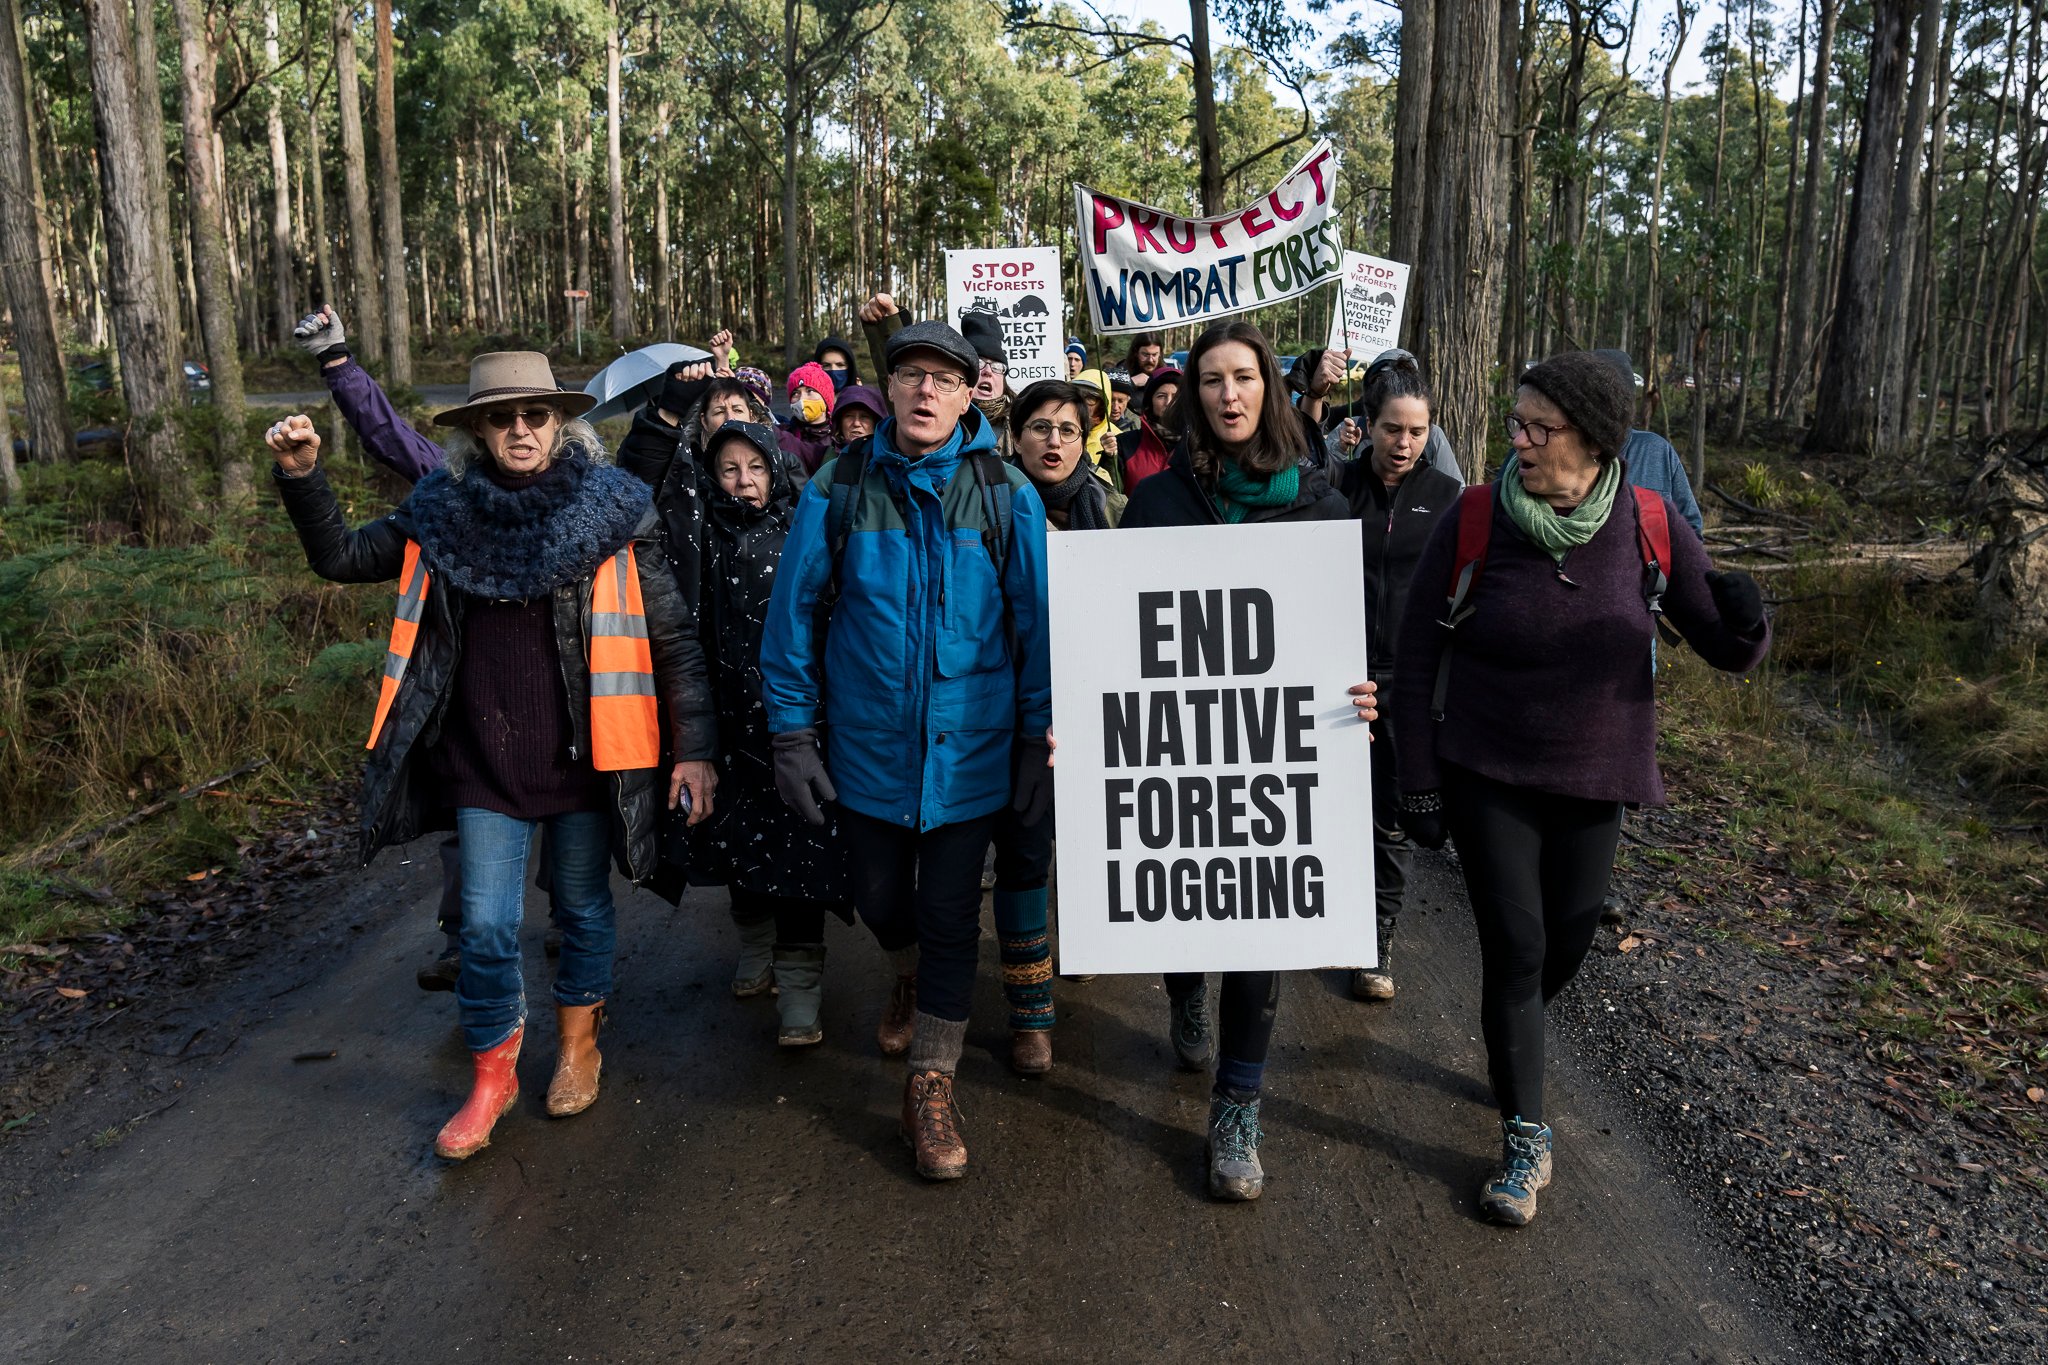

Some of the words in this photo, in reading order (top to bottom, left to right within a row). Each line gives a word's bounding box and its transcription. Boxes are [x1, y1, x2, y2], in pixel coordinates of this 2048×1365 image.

[1091, 149, 1331, 255] PROTECT
[972, 262, 1035, 279] STOP
[1090, 254, 1246, 327] WOMBAT
[1253, 215, 1341, 301] FORES
[1357, 263, 1394, 280] STOP
[1346, 300, 1393, 318] PROTECT
[1345, 309, 1392, 327] WOMBAT
[1347, 319, 1386, 334] FOREST
[1001, 322, 1046, 334] TECT
[1001, 335, 1046, 347] MBAT
[1360, 333, 1393, 349] FORESTS
[1003, 348, 1040, 360] EST
[1007, 366, 1056, 379] ORESTS
[1138, 587, 1276, 679] END
[1102, 685, 1318, 768] NATIVE
[1105, 772, 1319, 850] FOREST
[1106, 854, 1326, 923] LOGGING
